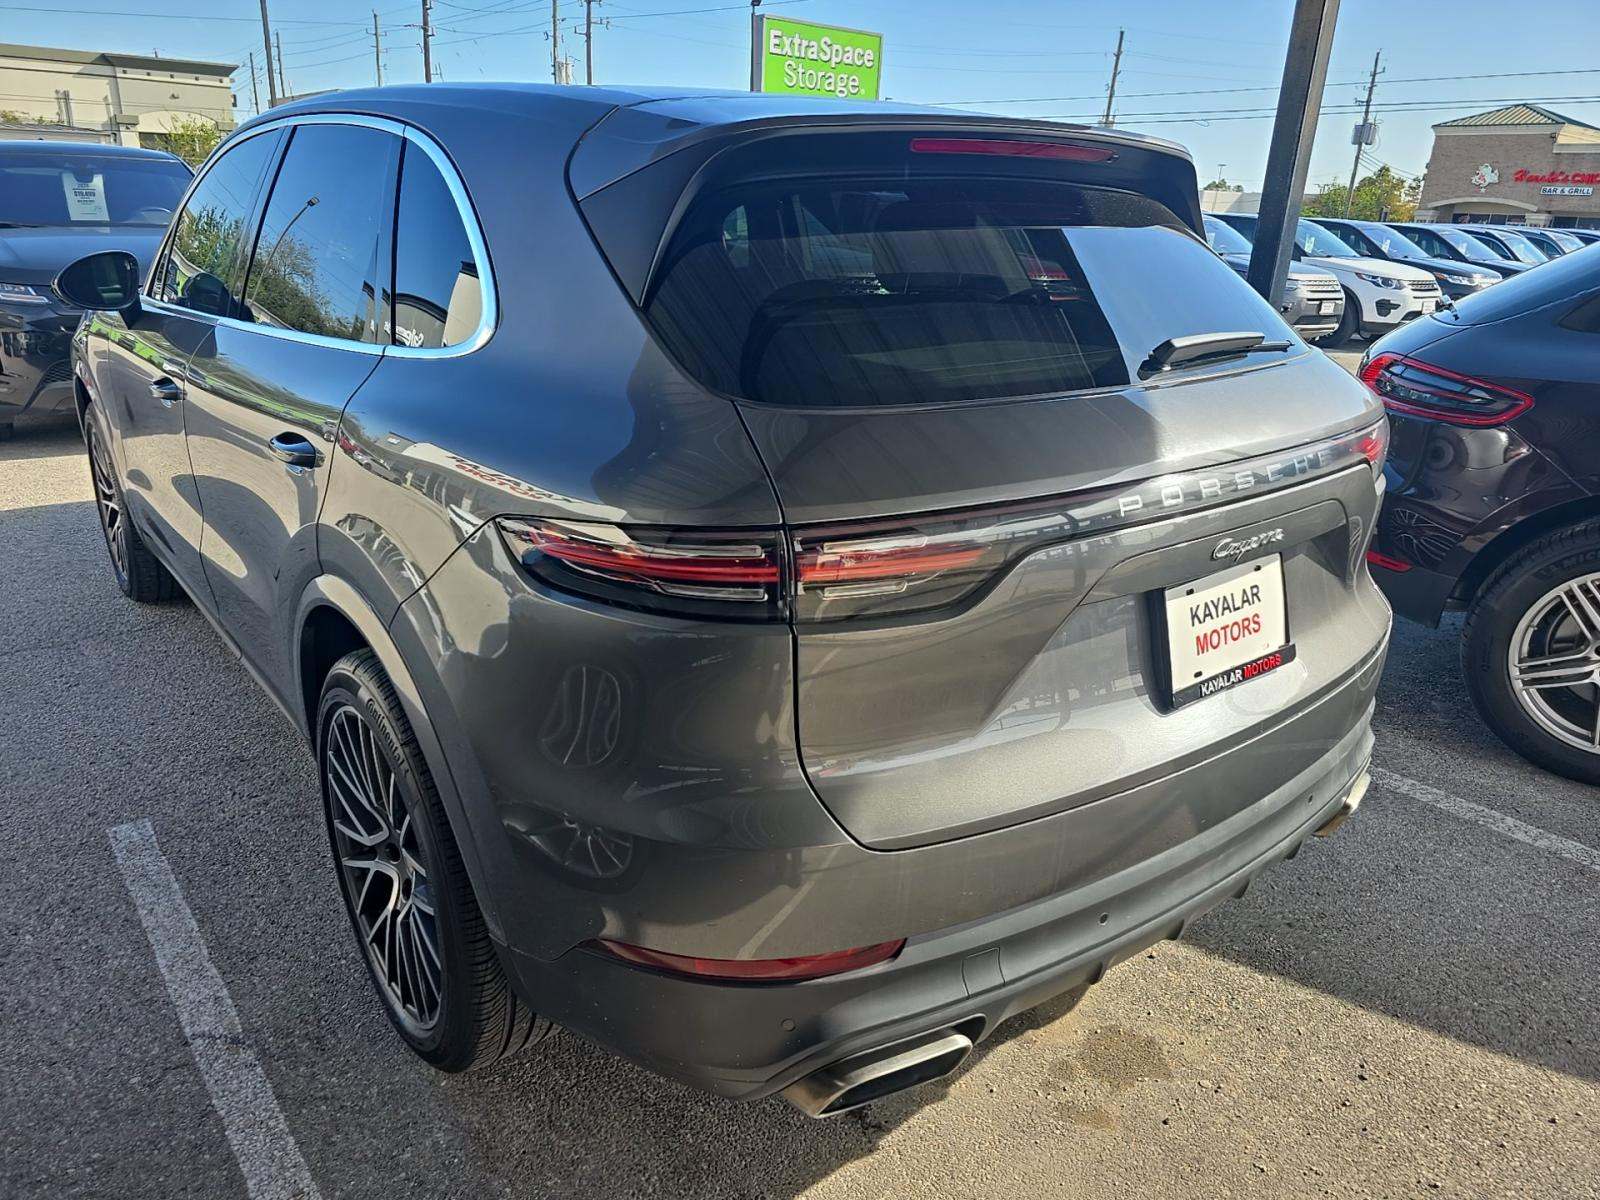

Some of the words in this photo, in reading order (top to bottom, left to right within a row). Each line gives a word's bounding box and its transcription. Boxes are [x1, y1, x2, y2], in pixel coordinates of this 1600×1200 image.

[784, 60, 860, 97] Storage
[1118, 452, 1328, 517] PORSCHE
[1211, 528, 1285, 562] Cayenne
[1190, 584, 1262, 627] KAYALAR
[1195, 613, 1262, 656] MOTORS
[1201, 668, 1243, 696] KAYALAR
[1244, 653, 1282, 679] MOTORS
[366, 697, 405, 767] Continental
